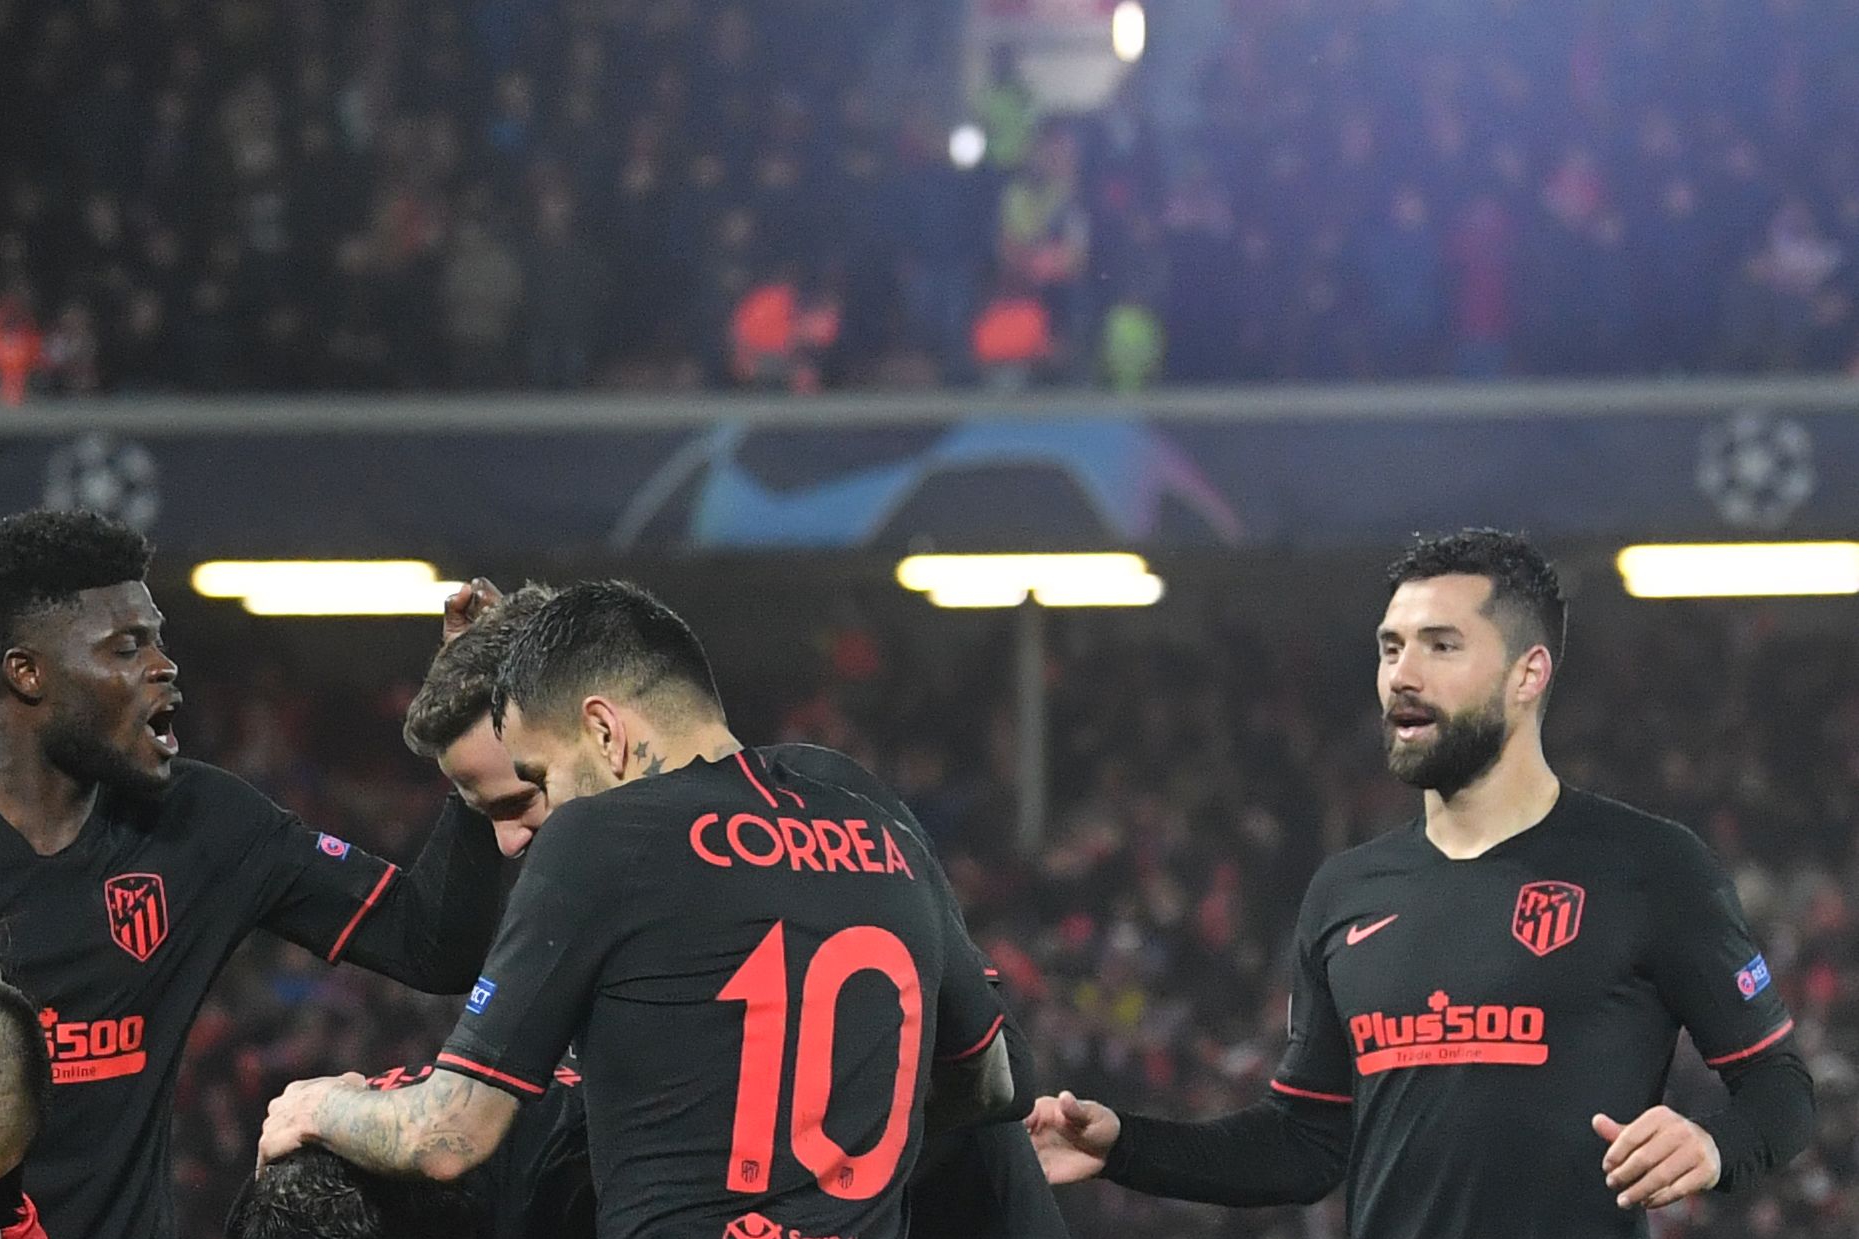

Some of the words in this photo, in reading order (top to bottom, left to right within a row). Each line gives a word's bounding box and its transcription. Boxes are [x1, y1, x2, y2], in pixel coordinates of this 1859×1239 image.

[689, 813, 914, 880] CORREA
[715, 919, 922, 1200] 10
[1349, 1003, 1545, 1054] Plus500
